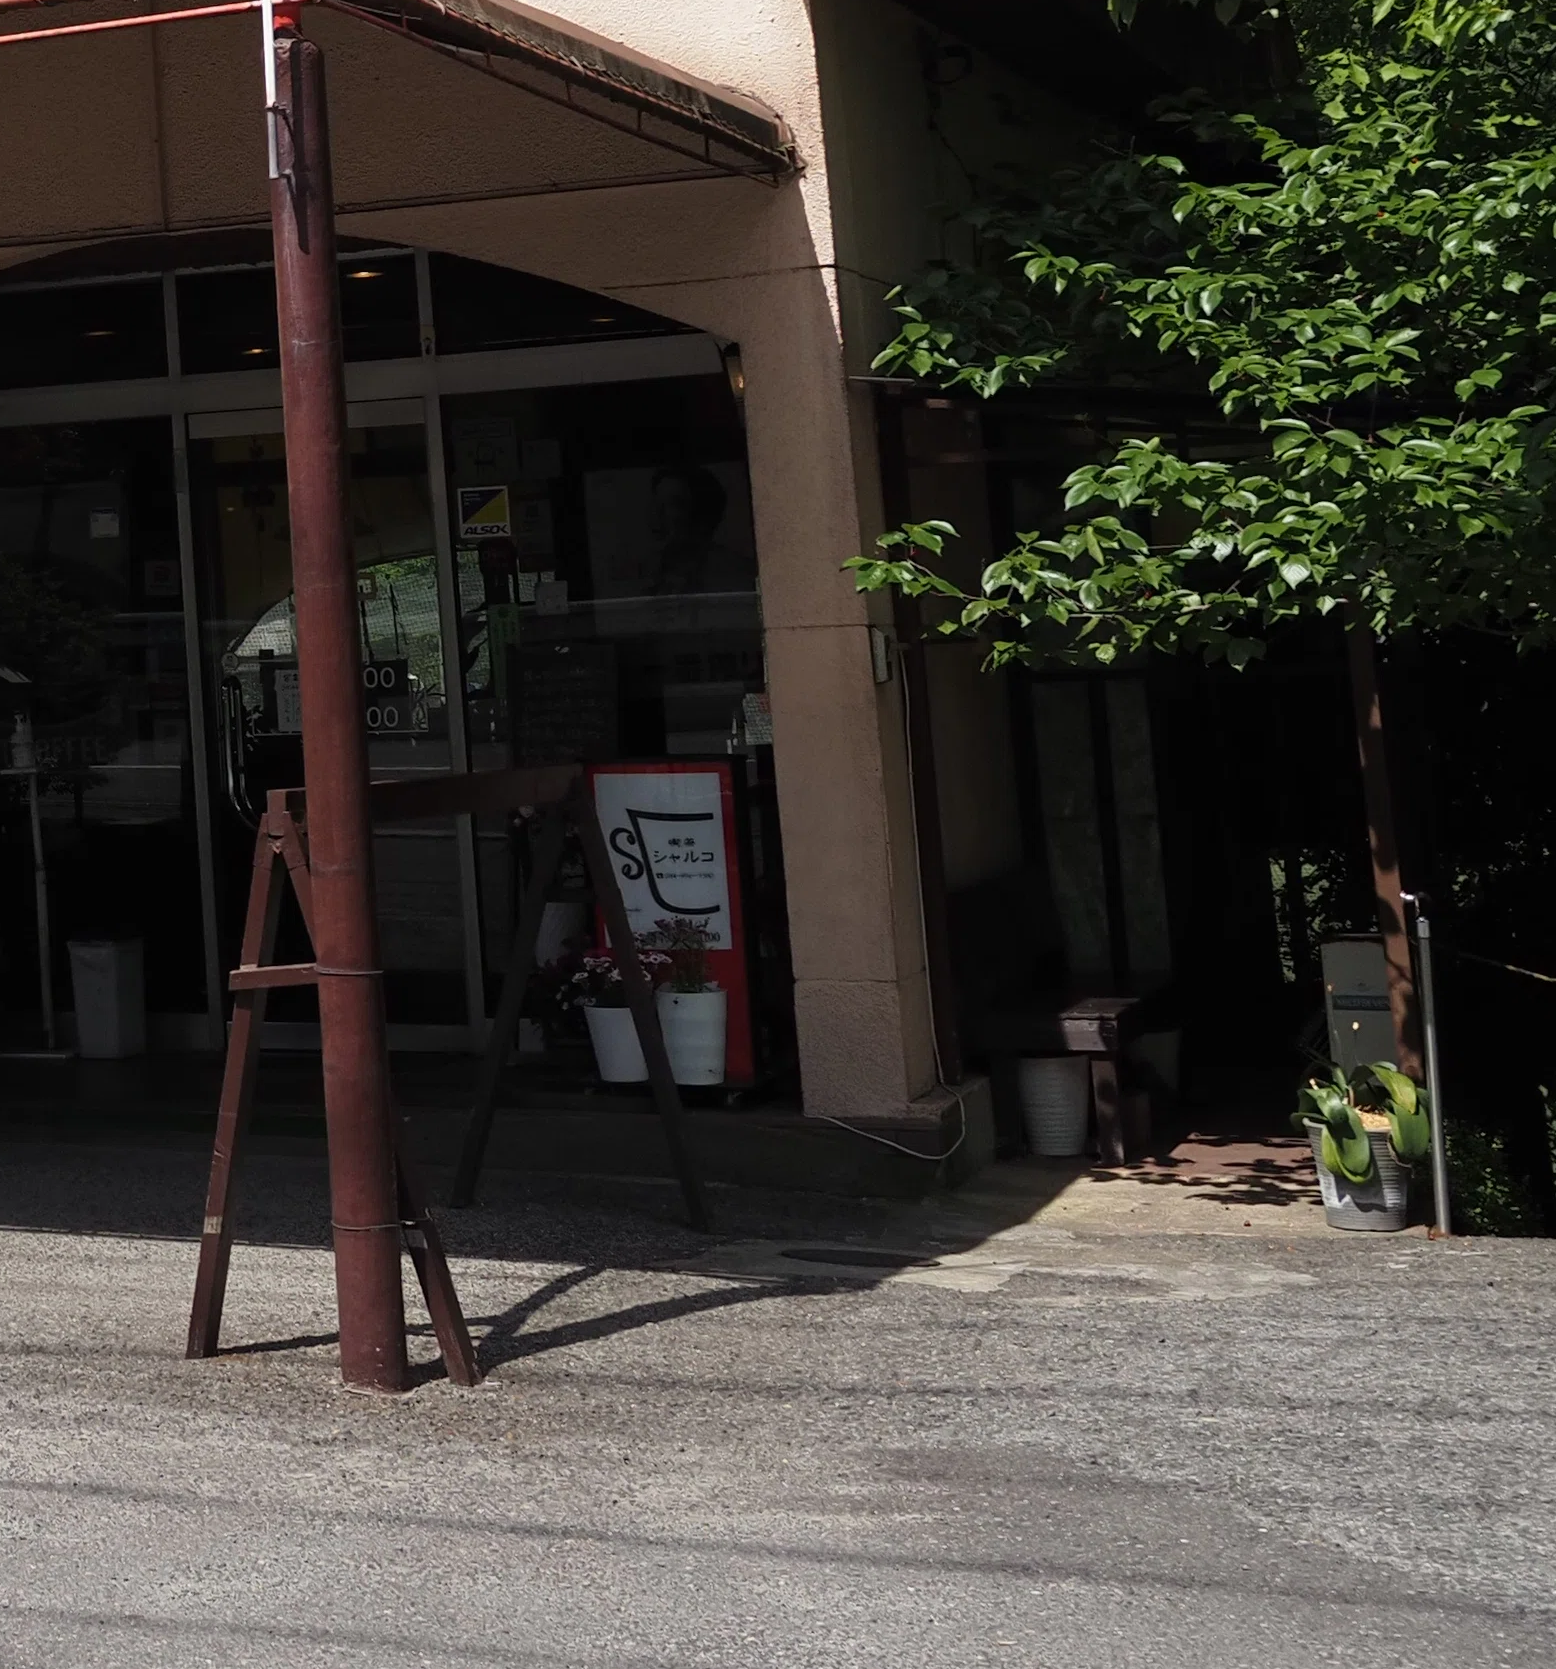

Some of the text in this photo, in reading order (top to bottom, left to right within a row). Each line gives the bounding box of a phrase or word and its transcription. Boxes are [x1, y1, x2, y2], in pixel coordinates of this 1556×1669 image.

[464, 524, 509, 535] ALSOK
[653, 850, 714, 863] シャルコ
